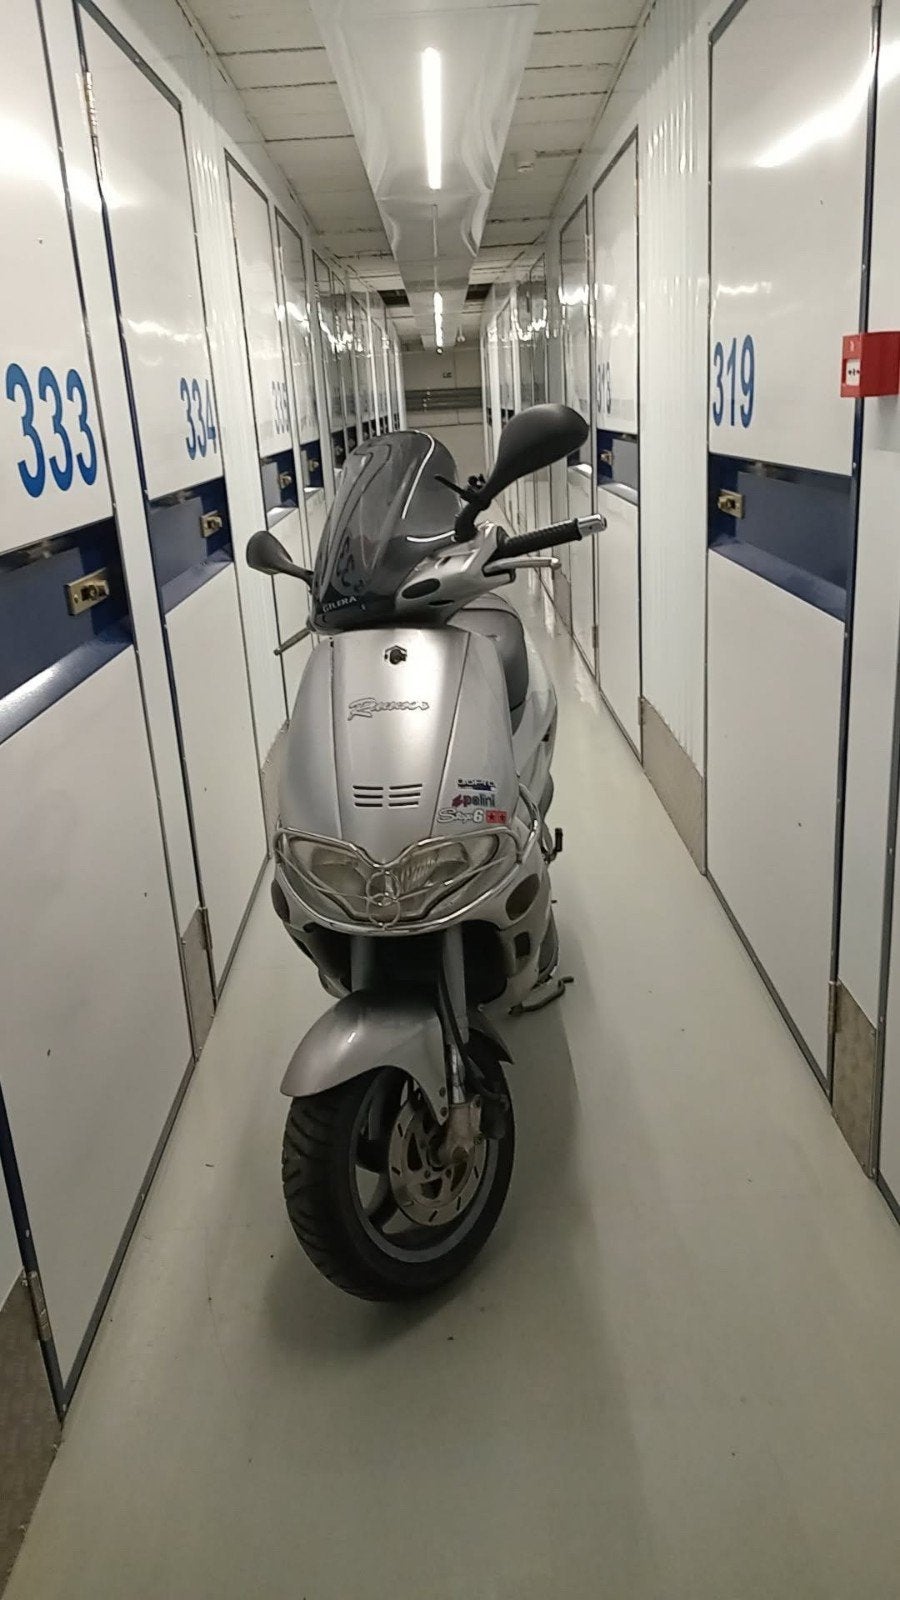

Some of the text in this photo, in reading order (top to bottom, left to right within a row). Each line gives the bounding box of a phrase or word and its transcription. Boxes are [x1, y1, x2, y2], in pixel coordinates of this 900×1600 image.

[180, 377, 217, 460] 334
[713, 334, 754, 428] 319
[6, 363, 97, 498] 333
[322, 595, 357, 613] GILERA
